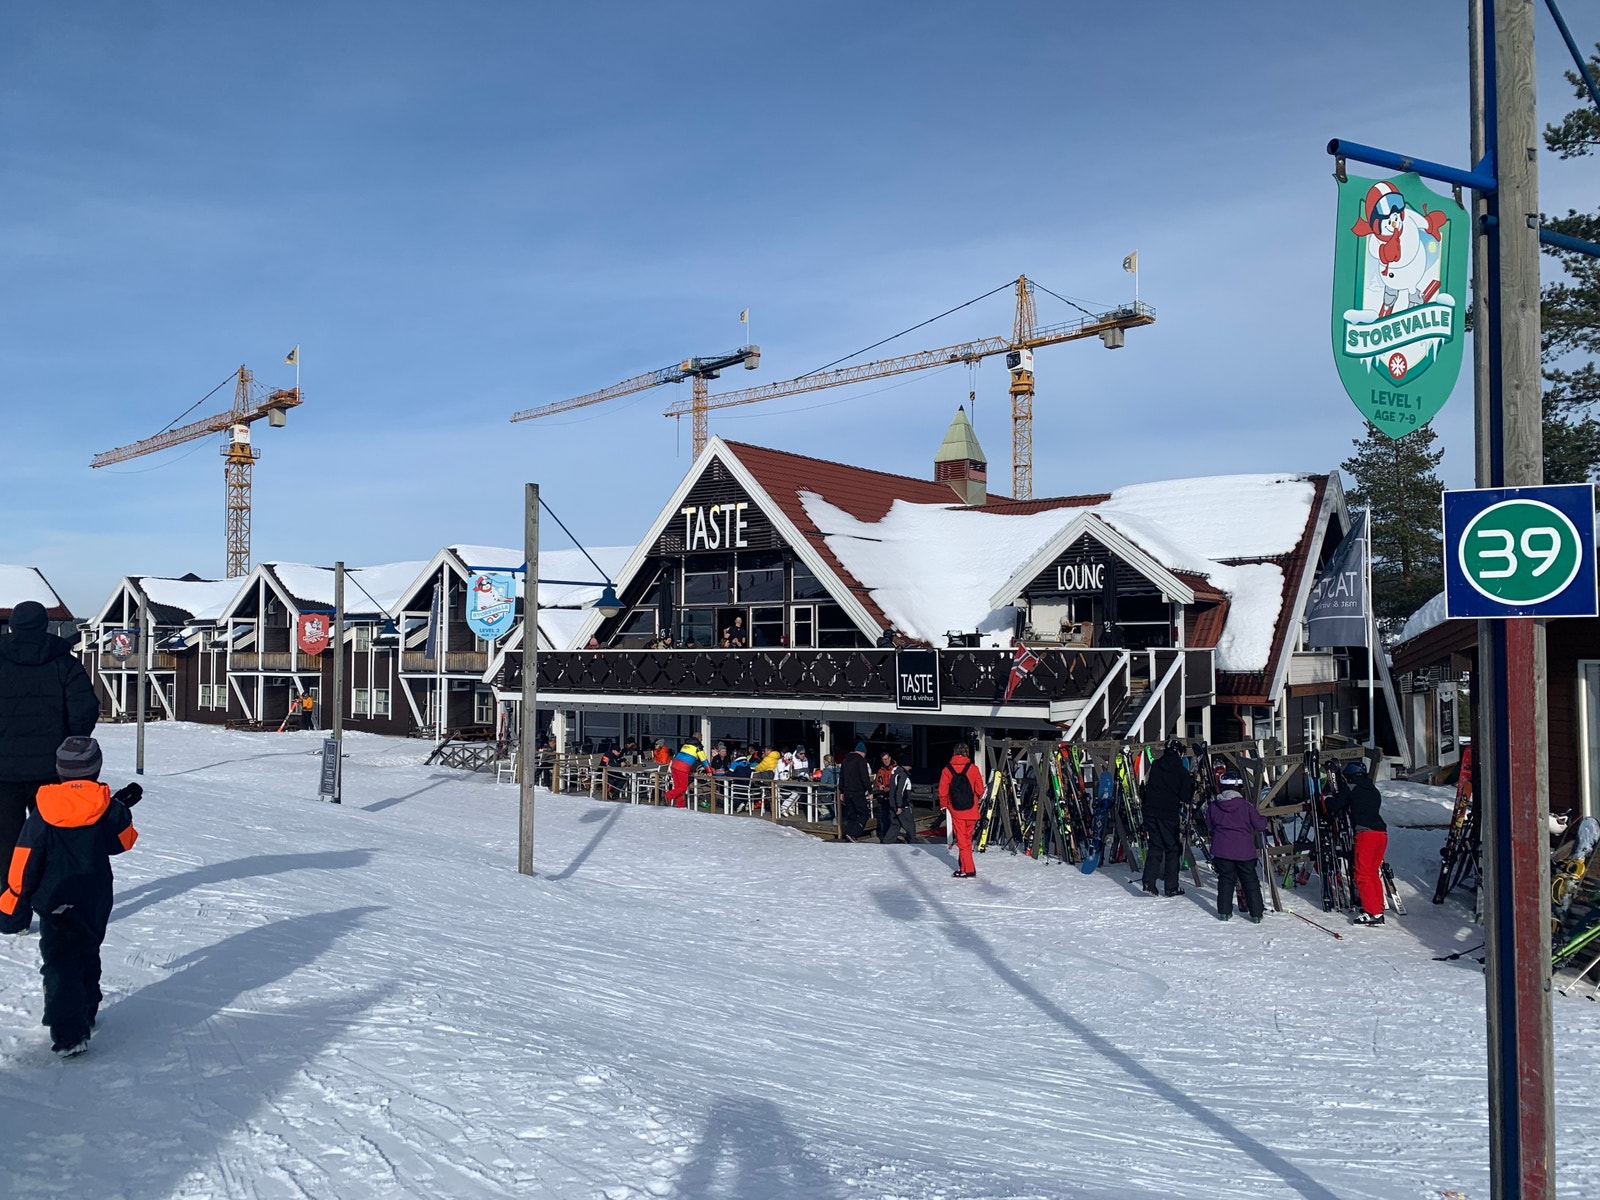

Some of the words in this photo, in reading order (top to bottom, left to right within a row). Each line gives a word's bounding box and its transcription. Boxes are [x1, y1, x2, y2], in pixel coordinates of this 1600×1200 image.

[1347, 310, 1450, 348] STOREVALLE
[1371, 389, 1411, 409] LEVEL
[1416, 396, 1422, 410] 1
[1374, 409, 1396, 422] AGE
[1398, 411, 1417, 425] 7-9
[681, 502, 748, 550] TASTE
[1477, 526, 1561, 578] 39
[1057, 563, 1105, 591] LOUNG
[901, 674, 934, 694] TASTE
[918, 694, 934, 702] vinhus
